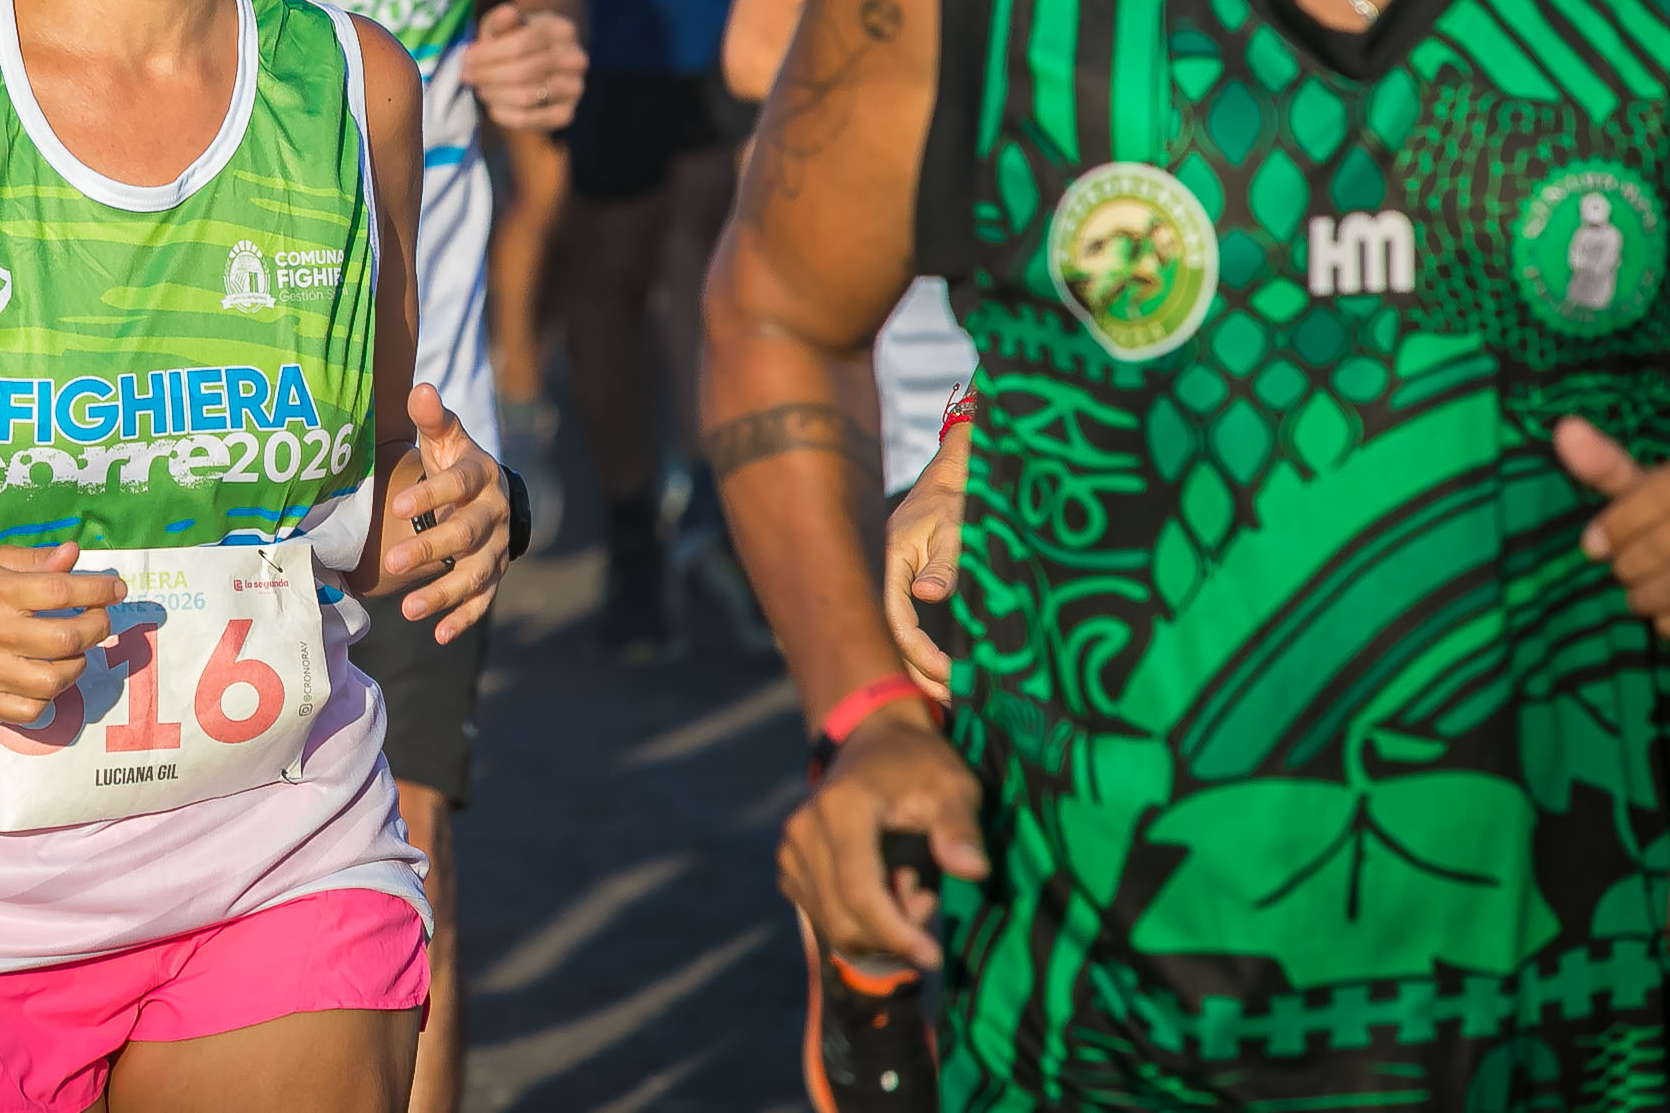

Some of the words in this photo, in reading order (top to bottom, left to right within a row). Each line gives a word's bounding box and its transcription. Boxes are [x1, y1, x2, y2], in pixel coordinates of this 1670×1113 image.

[278, 287, 324, 302] Gestión
[154, 591, 207, 613] 2026
[95, 768, 154, 786] LUCIANA
[157, 764, 179, 781] GIL
